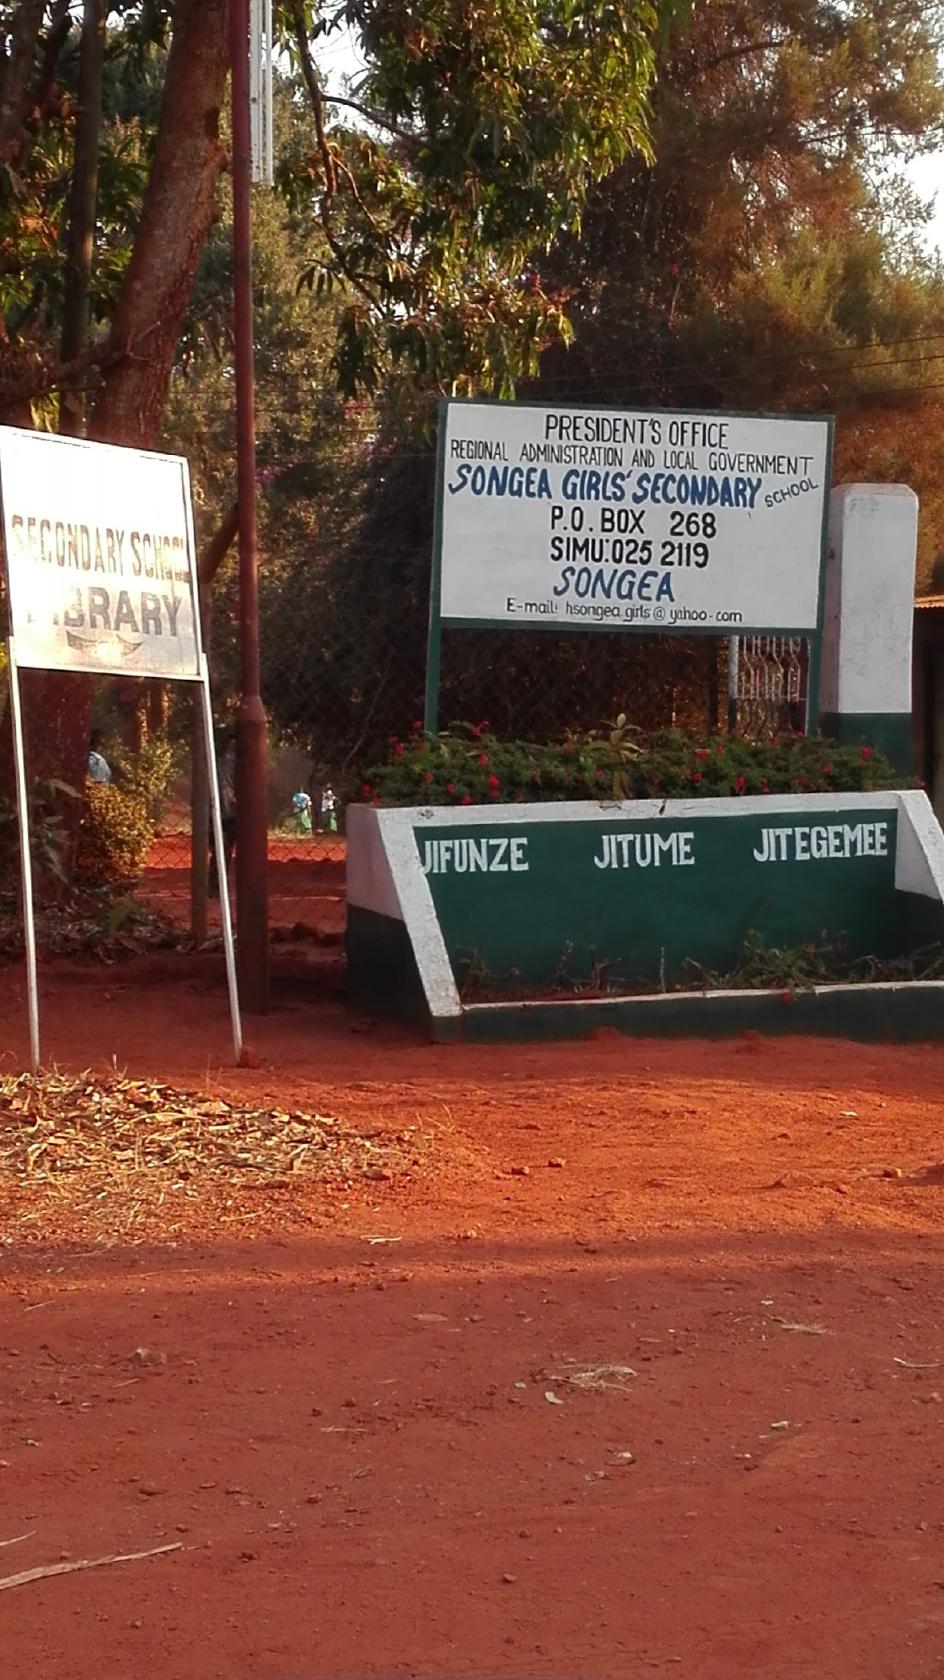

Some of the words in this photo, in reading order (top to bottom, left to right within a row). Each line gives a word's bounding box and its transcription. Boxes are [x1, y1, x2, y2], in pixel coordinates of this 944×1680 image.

[545, 414, 662, 446] PRESIDENT'S
[668, 420, 729, 450] OFFICE
[450, 439, 509, 462] REGIONAL
[519, 443, 623, 467] ADMINISTRATION
[631, 449, 656, 469] AND
[663, 450, 699, 471] LOCAL
[708, 452, 814, 476] GOVERNMENT
[448, 463, 552, 499] SONGEA
[631, 472, 762, 509] SECONDARY
[764, 478, 819, 508] SCHOOL
[601, 508, 646, 535] BOX
[669, 510, 717, 539] 268
[660, 540, 710, 569] 2119
[553, 566, 676, 603] SONGEA
[423, 837, 529, 874] JIFUNZE
[594, 832, 695, 869] JITUME
[753, 822, 888, 862] JITEGEMEE
